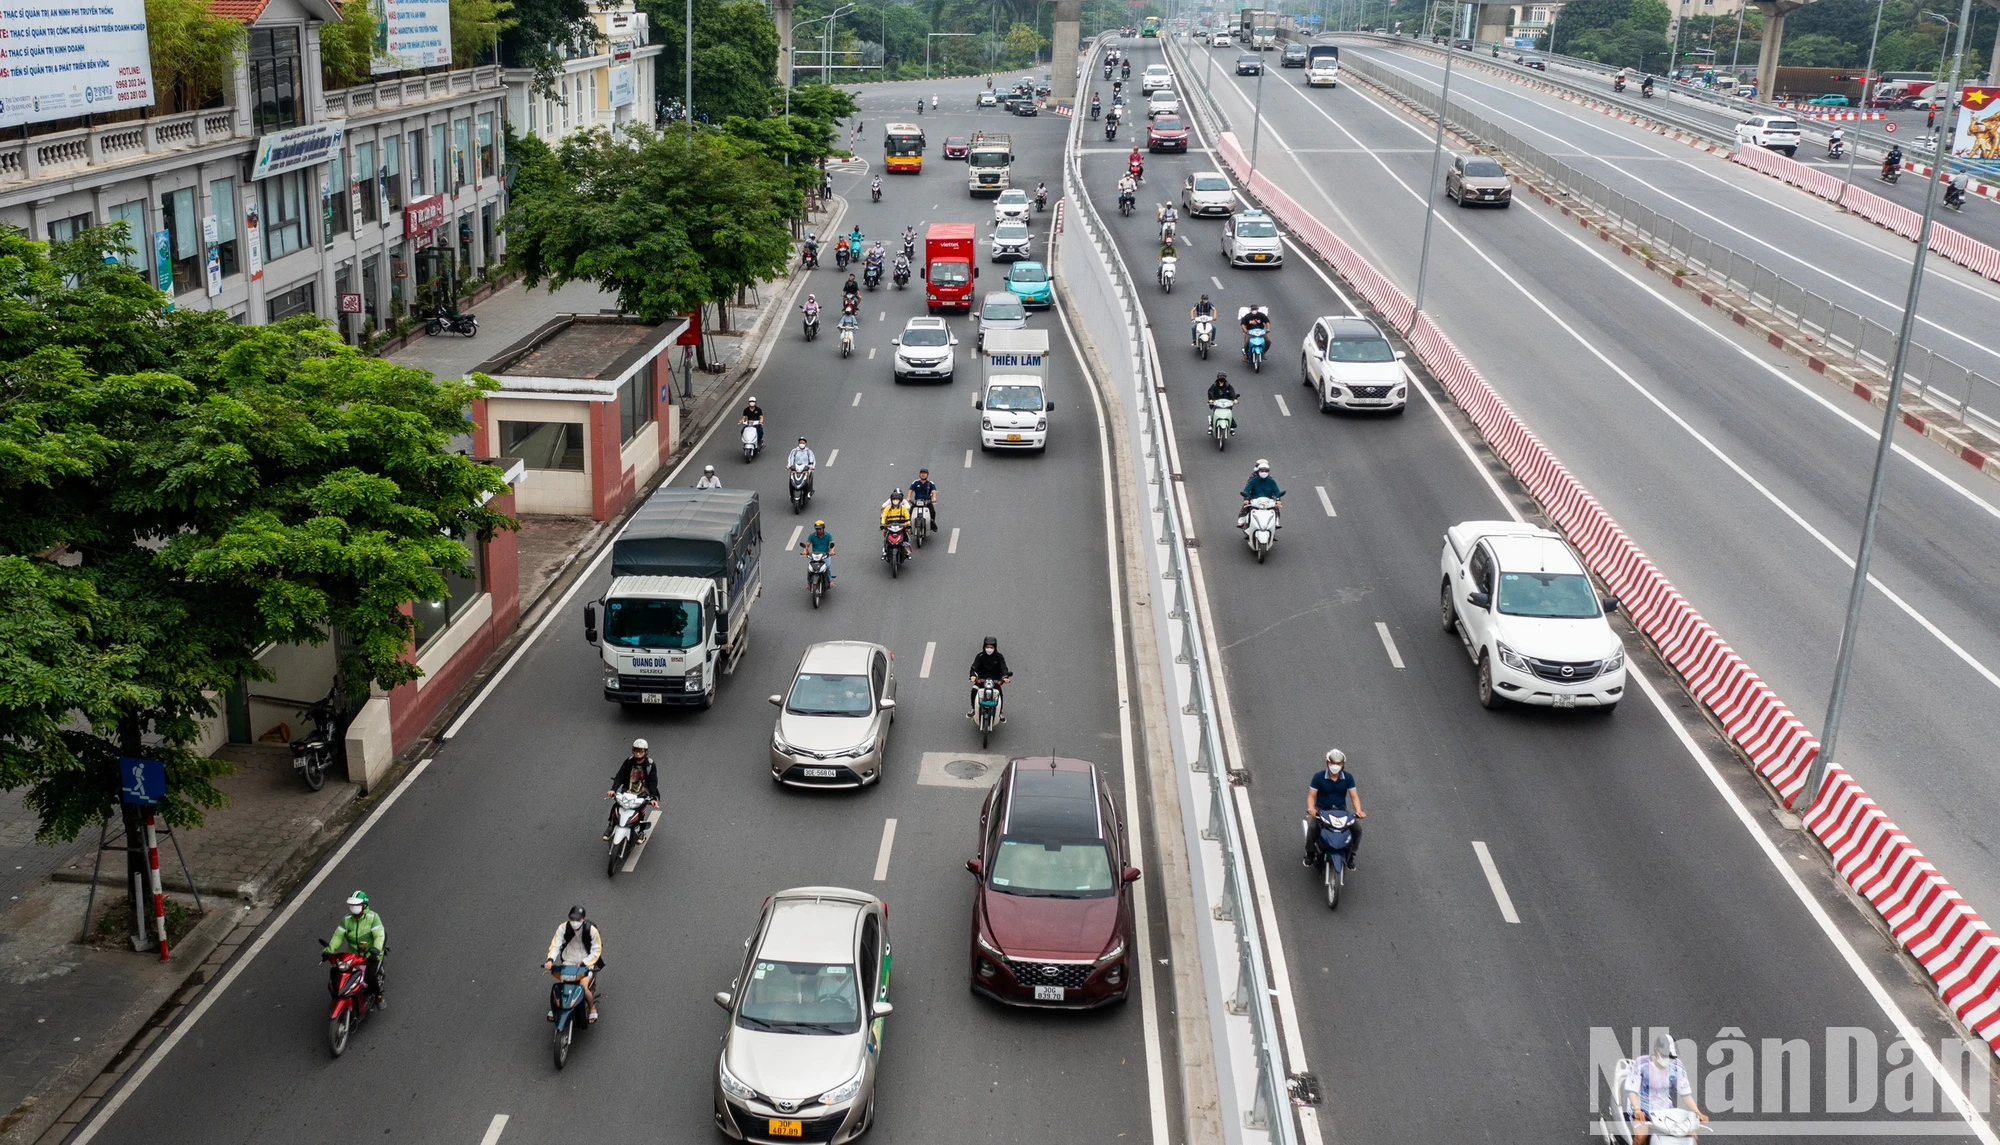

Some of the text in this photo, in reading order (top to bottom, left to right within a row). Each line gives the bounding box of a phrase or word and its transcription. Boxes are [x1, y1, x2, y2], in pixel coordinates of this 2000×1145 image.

[3, 11, 18, 20] THẠC
[25, 7, 40, 19] QUẢN
[51, 9, 58, 17] AN
[58, 8, 70, 17] NINH
[71, 8, 79, 16] PHI
[10, 29, 25, 40] THẠC
[31, 26, 47, 38] QUẢN
[56, 25, 70, 35] CÔNG
[115, 24, 130, 32] DOANH
[9, 49, 23, 59] THẠC
[30, 45, 45, 57] QUẢN
[55, 46, 67, 54] KINH
[68, 44, 85, 52] DOANH
[29, 63, 45, 76] QUẢN
[118, 67, 141, 75] HOTLINE:
[116, 78, 147, 89] 0968 202 244
[991, 354, 1041, 366] THIÊN LÂM
[632, 657, 653, 668] QUANG
[778, 1120, 792, 1128] 30F
